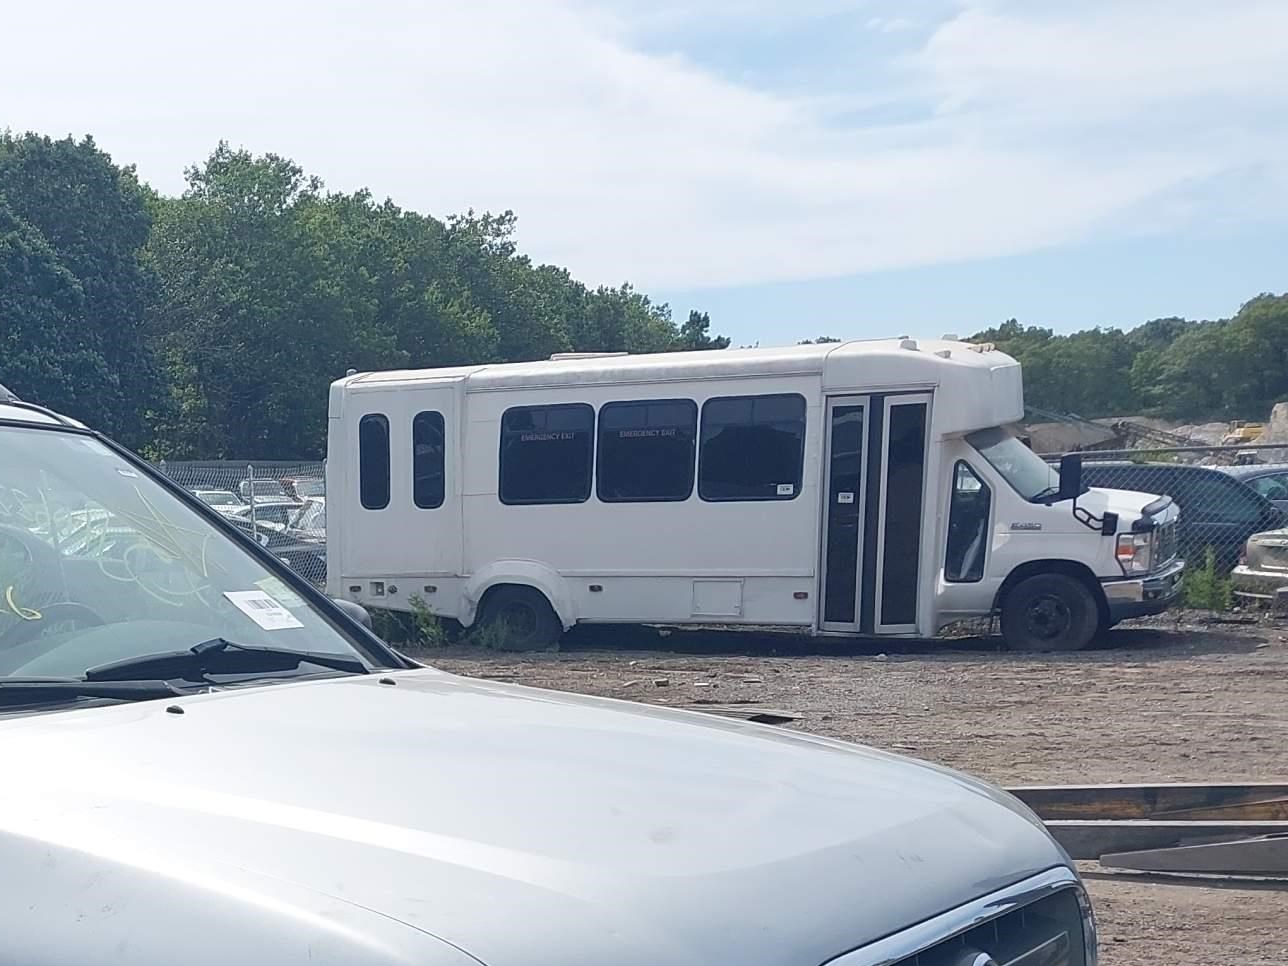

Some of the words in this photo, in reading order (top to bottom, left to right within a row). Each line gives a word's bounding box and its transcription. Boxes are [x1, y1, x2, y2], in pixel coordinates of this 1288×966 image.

[521, 432, 560, 442] EMERGENCY
[561, 432, 575, 440] EXIT
[619, 430, 659, 438] EMERGENCY
[661, 428, 677, 437] EXIT
